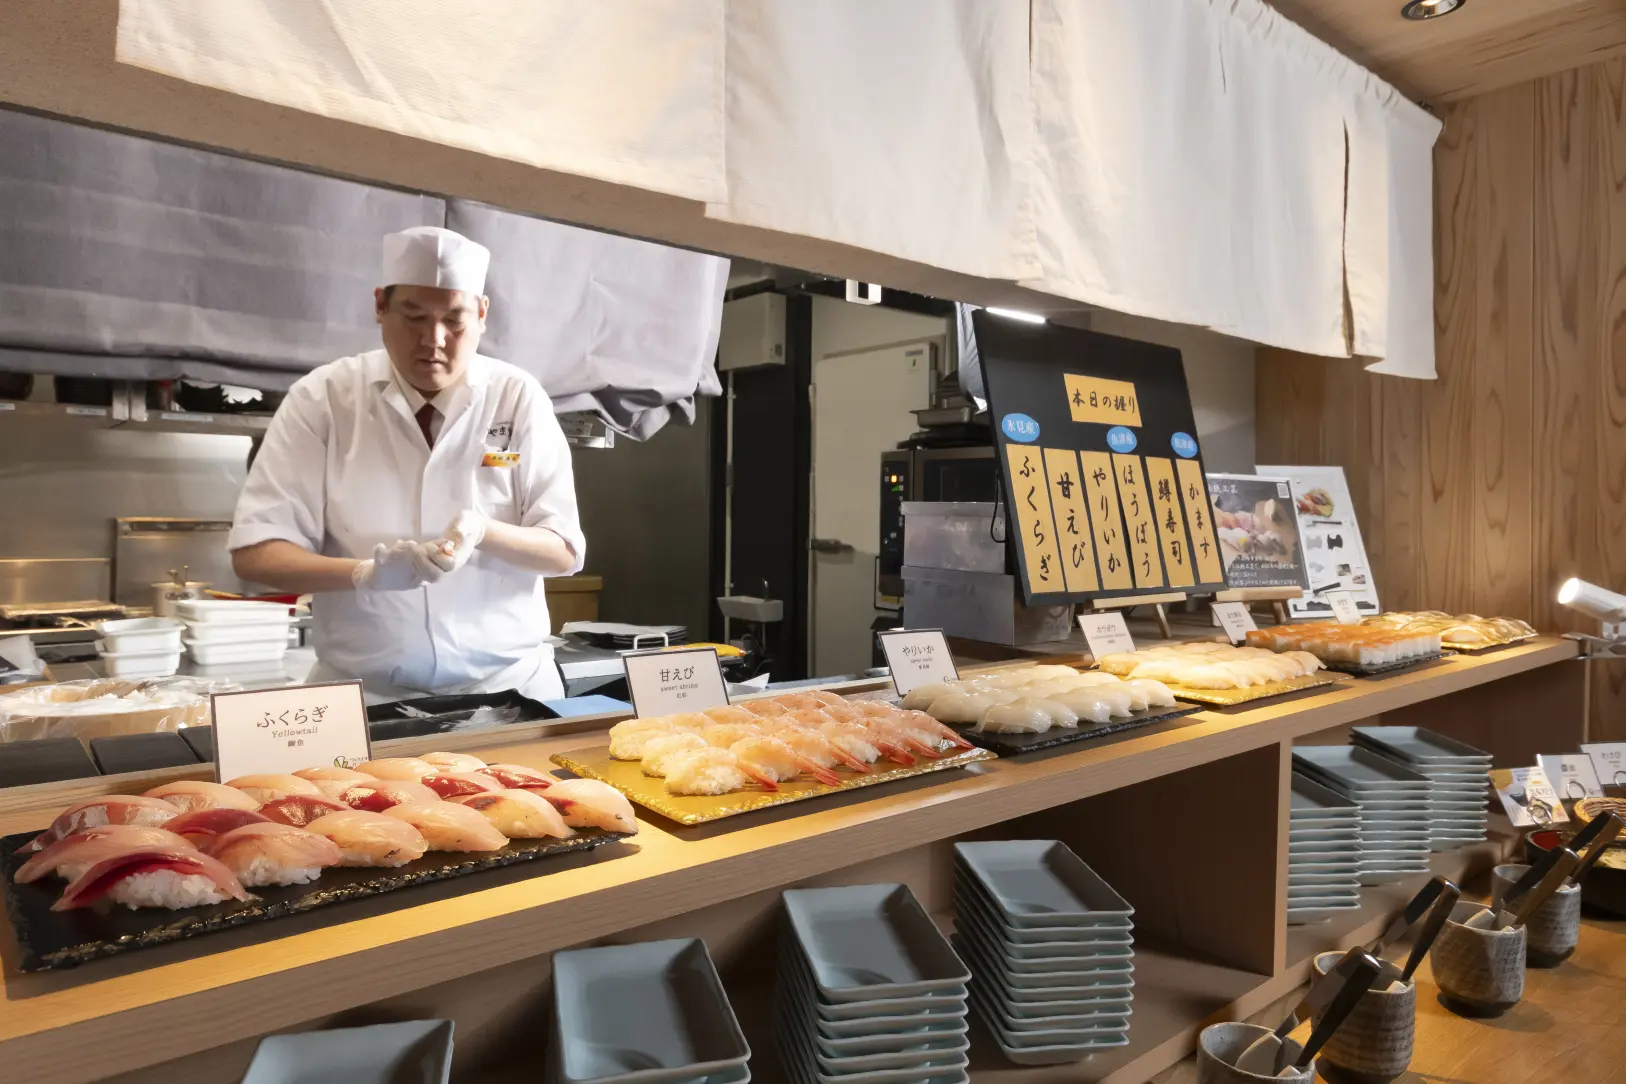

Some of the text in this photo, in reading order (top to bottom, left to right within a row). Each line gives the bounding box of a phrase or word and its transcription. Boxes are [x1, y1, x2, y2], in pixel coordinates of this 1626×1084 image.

[1072, 388, 1136, 414] 本日の握り
[1019, 455, 1051, 581] ふくらぎ
[1056, 471, 1086, 568] 甘えび
[1092, 467, 1121, 573] やりいか
[1123, 464, 1150, 578] ほうぼう
[1157, 478, 1183, 566] 鱒寿司
[1189, 483, 1210, 559] かます
[659, 665, 695, 682] 甘えび
[902, 645, 934, 656] やりいか
[256, 705, 329, 728] ふくらぎ
[271, 726, 318, 738] Yellowtail
